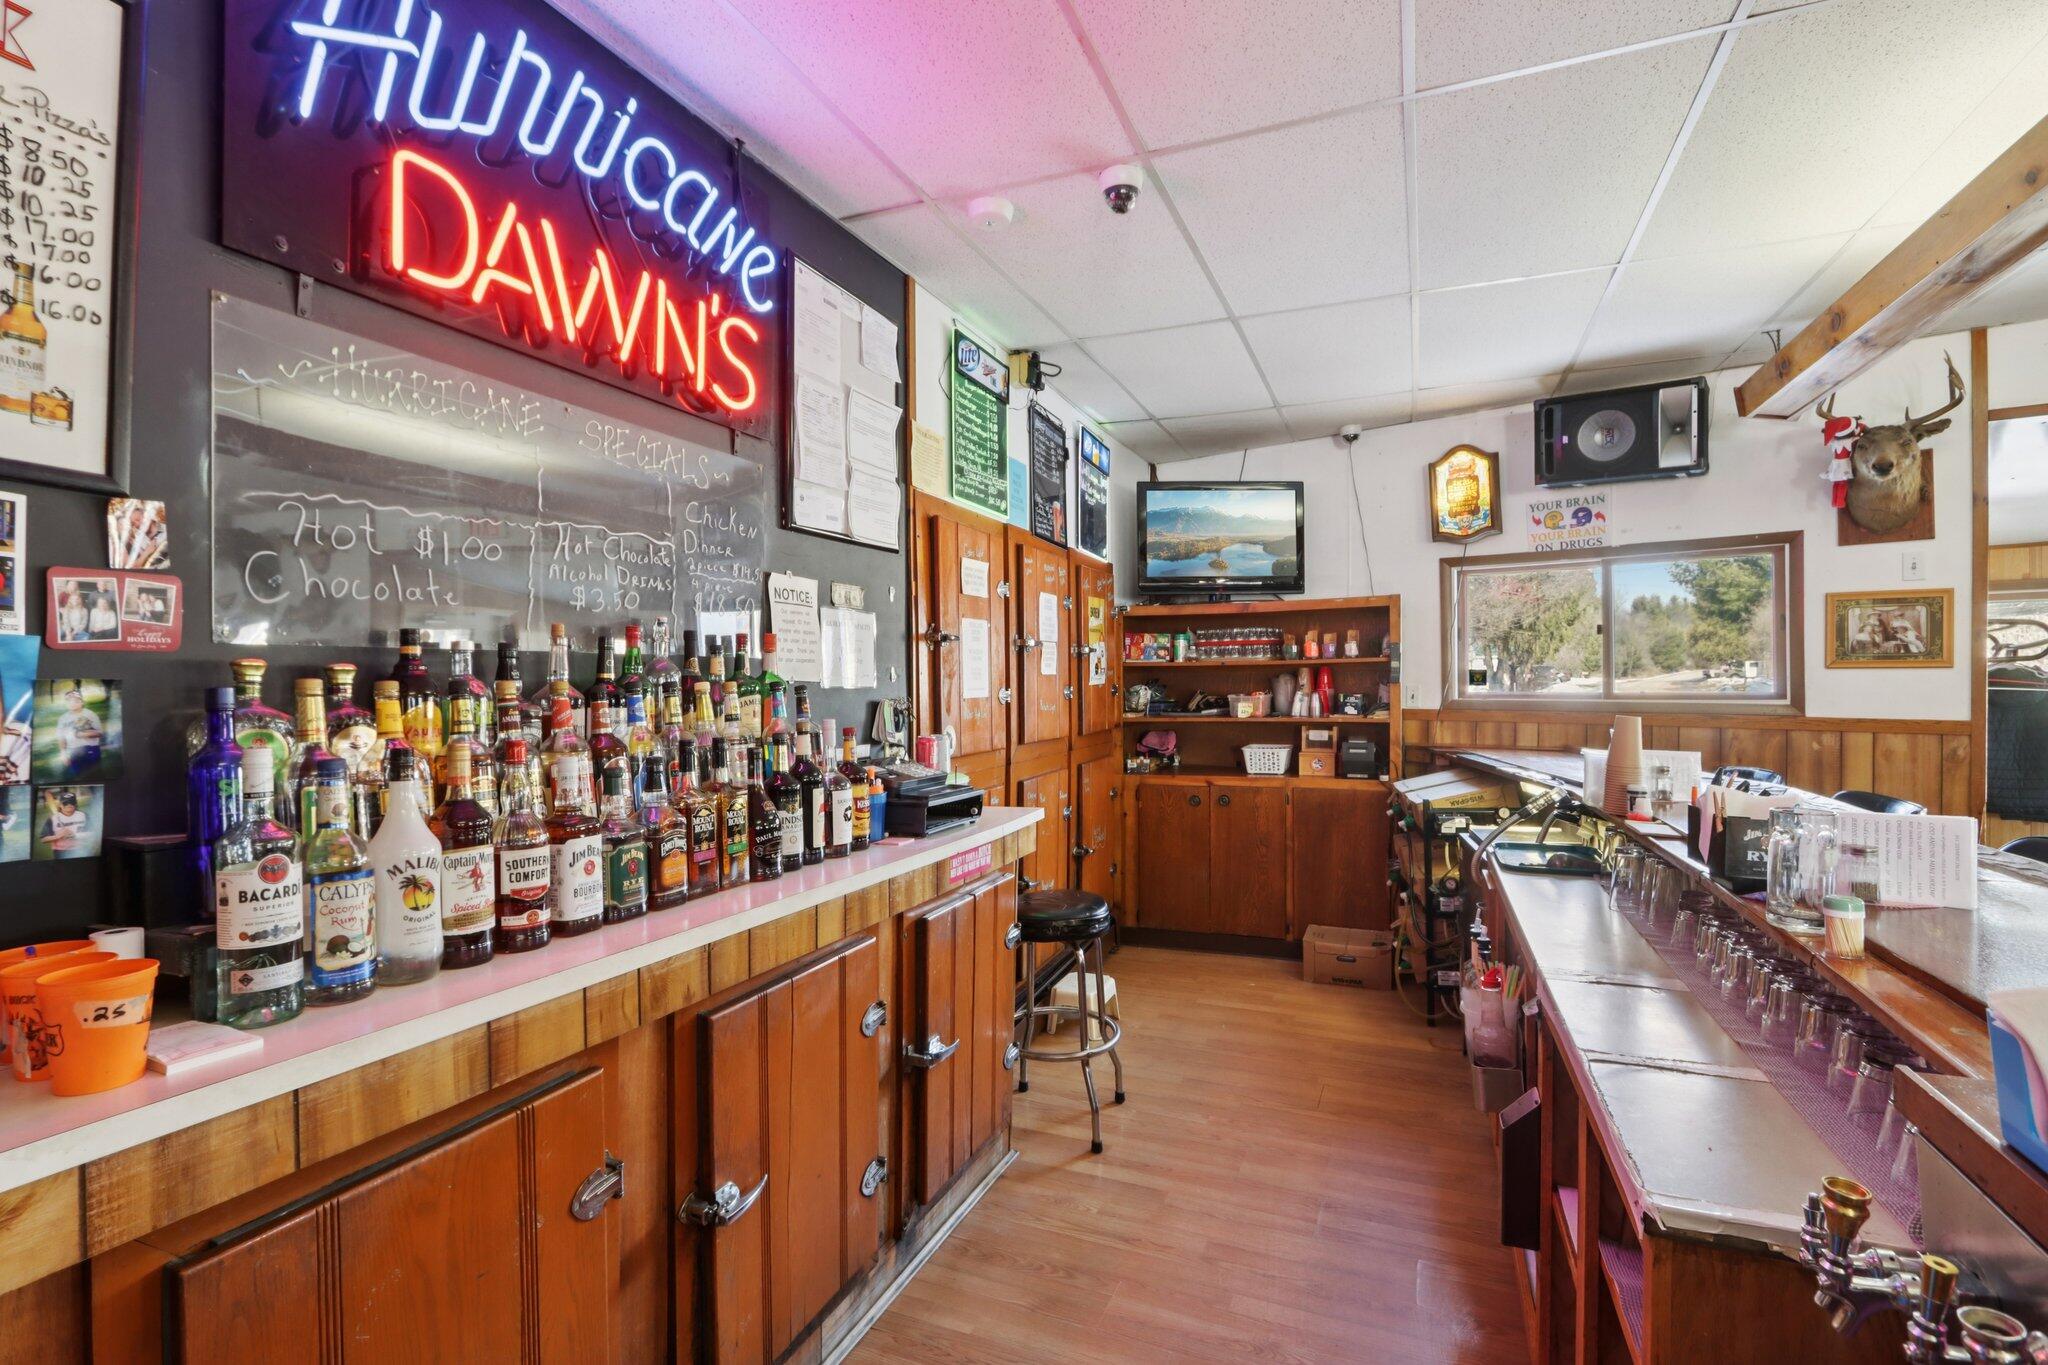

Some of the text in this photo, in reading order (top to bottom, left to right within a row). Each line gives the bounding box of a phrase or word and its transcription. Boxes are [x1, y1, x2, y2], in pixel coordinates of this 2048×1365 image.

[391, 148, 760, 413] DAWN'S
[318, 345, 545, 436] HURRICANE
[577, 418, 710, 488] SPECIALS
[1529, 495, 1606, 513] YOUR BRAIN
[277, 502, 502, 564] Hot $1.00
[1531, 525, 1606, 543] YOUR BRAIN
[553, 525, 672, 568] Hot Chocolate
[1535, 537, 1603, 552] ON DRUGS
[244, 549, 460, 607] Chocolate
[549, 564, 609, 583] Alcohol
[569, 584, 640, 613] $3.50
[774, 587, 813, 605] NOTICE:
[127, 636, 171, 644] HOLIDAYS
[693, 815, 714, 824] MOUNT
[727, 810, 745, 819] MOUNT
[728, 817, 745, 826] ROYAL
[695, 823, 714, 833] ROYAL
[755, 833, 772, 844] PAUL
[443, 852, 477, 872] Captain
[569, 849, 587, 868] JIM
[509, 868, 548, 883] COMFORT
[623, 876, 645, 887] RYE
[319, 901, 366, 917] Coconut
[451, 902, 481, 914] Spiced
[331, 916, 359, 931] Rum
[83, 1003, 127, 1023] .25
